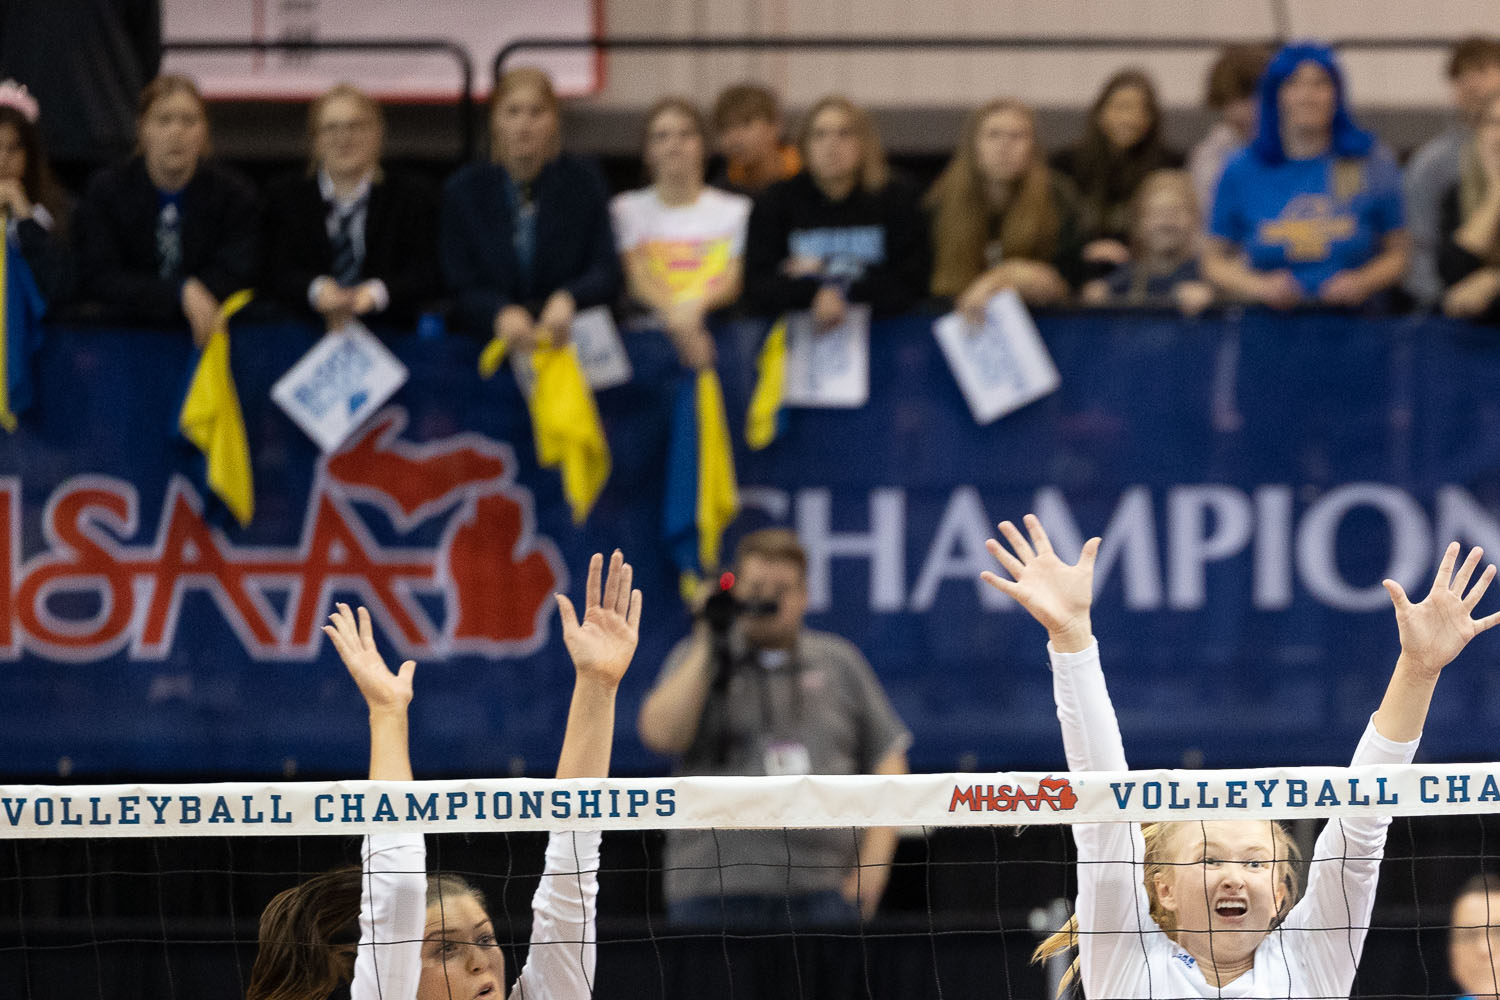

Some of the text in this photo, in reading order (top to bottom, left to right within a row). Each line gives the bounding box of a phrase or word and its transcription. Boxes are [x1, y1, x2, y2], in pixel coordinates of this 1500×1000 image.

[0, 464, 452, 662] SAA
[4, 788, 676, 826] VOLLEYBALL CHAMPIONSHIPS
[948, 780, 1066, 812] MHSAA
[1110, 777, 1399, 810] VOLLEYBALL
